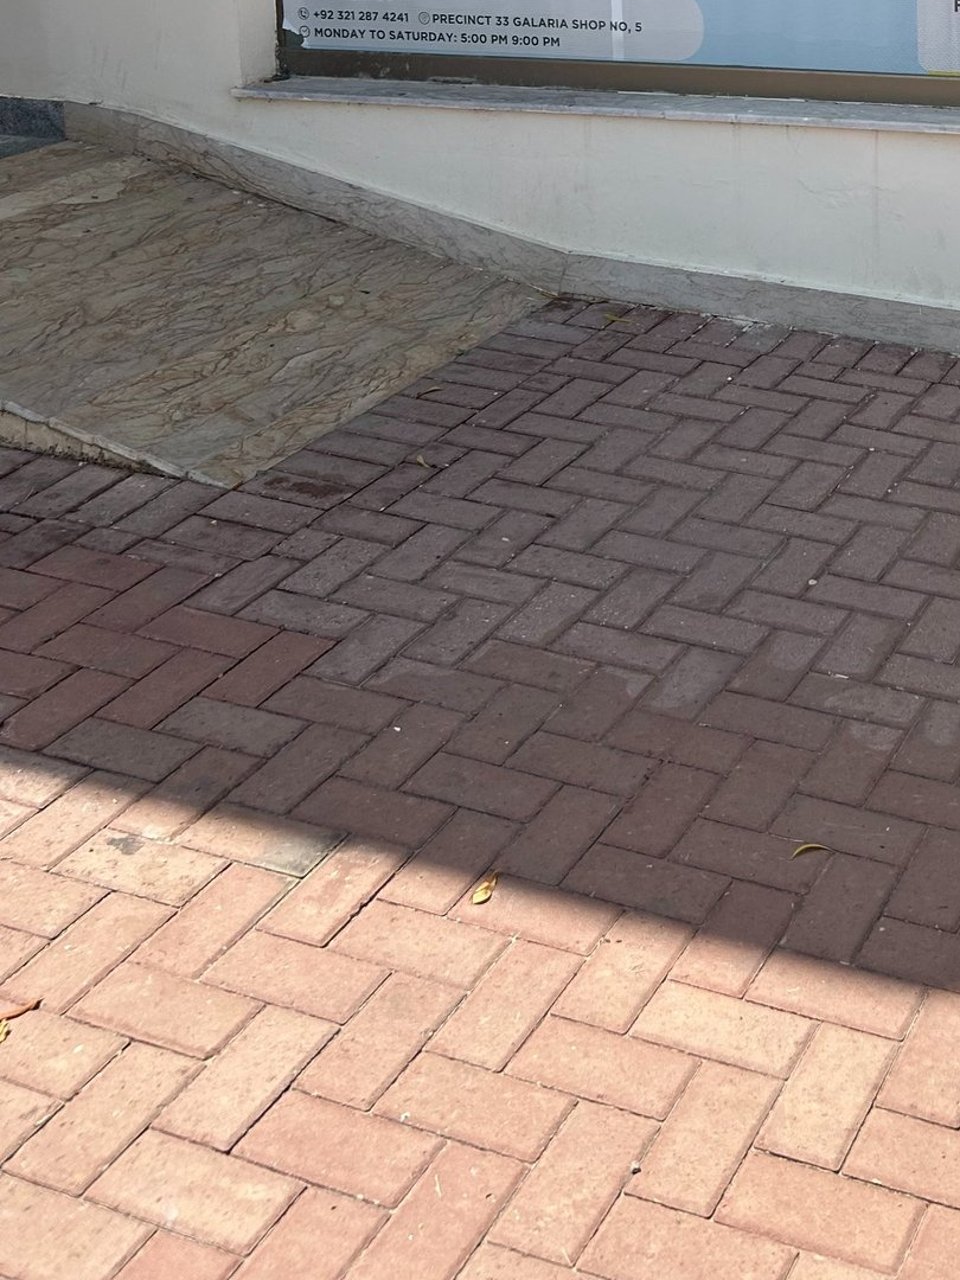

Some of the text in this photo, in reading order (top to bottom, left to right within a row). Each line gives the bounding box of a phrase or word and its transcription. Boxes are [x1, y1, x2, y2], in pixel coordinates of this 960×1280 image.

[313, 9, 409, 23] +92 321 287 4241
[432, 13, 642, 34] PRECINCT 33 GALARIA SHOP NO, 5
[313, 27, 561, 47] MONDAY TO SATURDAY: 5:00 PM 9:00 PM
